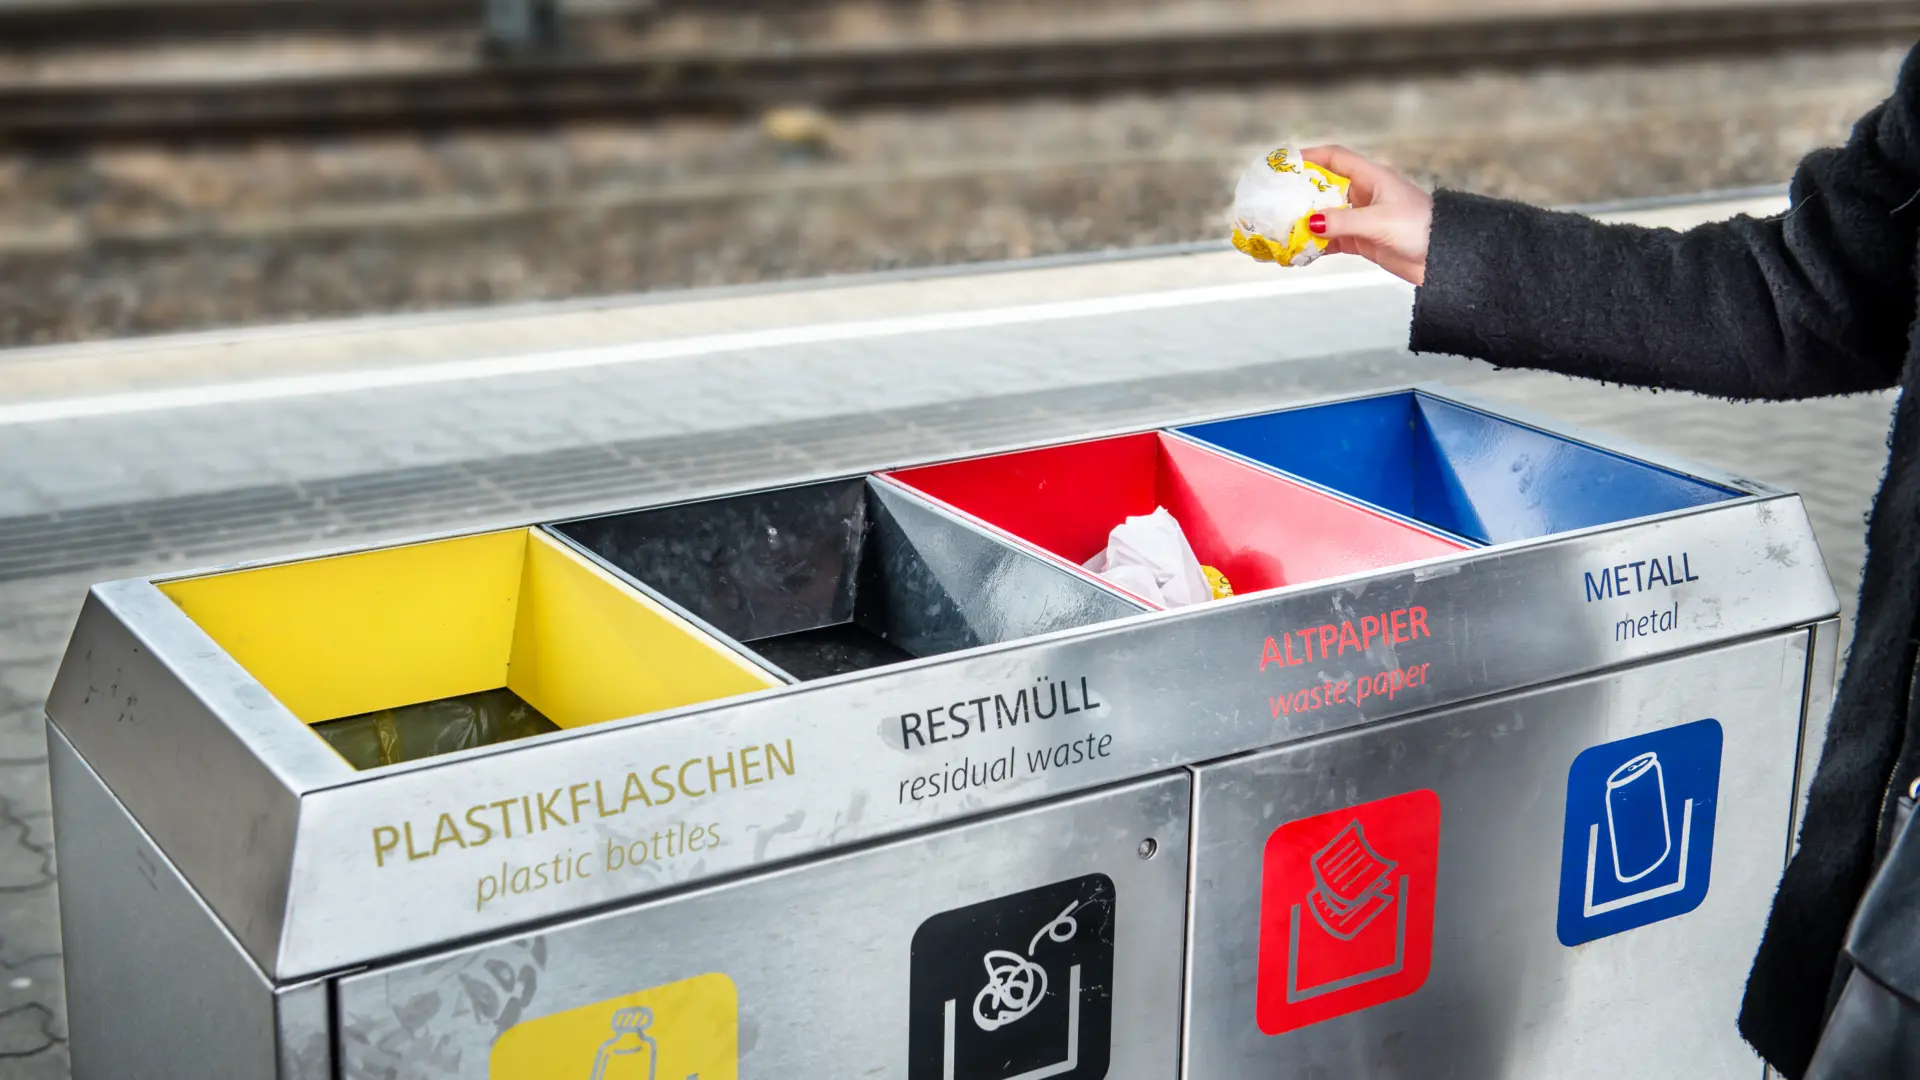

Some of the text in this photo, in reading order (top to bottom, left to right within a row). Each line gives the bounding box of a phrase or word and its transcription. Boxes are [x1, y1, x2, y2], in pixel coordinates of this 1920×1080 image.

[1584, 552, 1699, 602] METALL
[1260, 605, 1431, 673] ALTPAPIER
[1615, 602, 1678, 641] metal
[900, 676, 1101, 750] RESTMÜLL
[1269, 659, 1431, 718] waste paper
[372, 738, 796, 867] PLASTIKFLASCHEN
[899, 733, 1112, 804] residual waste
[475, 820, 721, 912] plastic bottles
